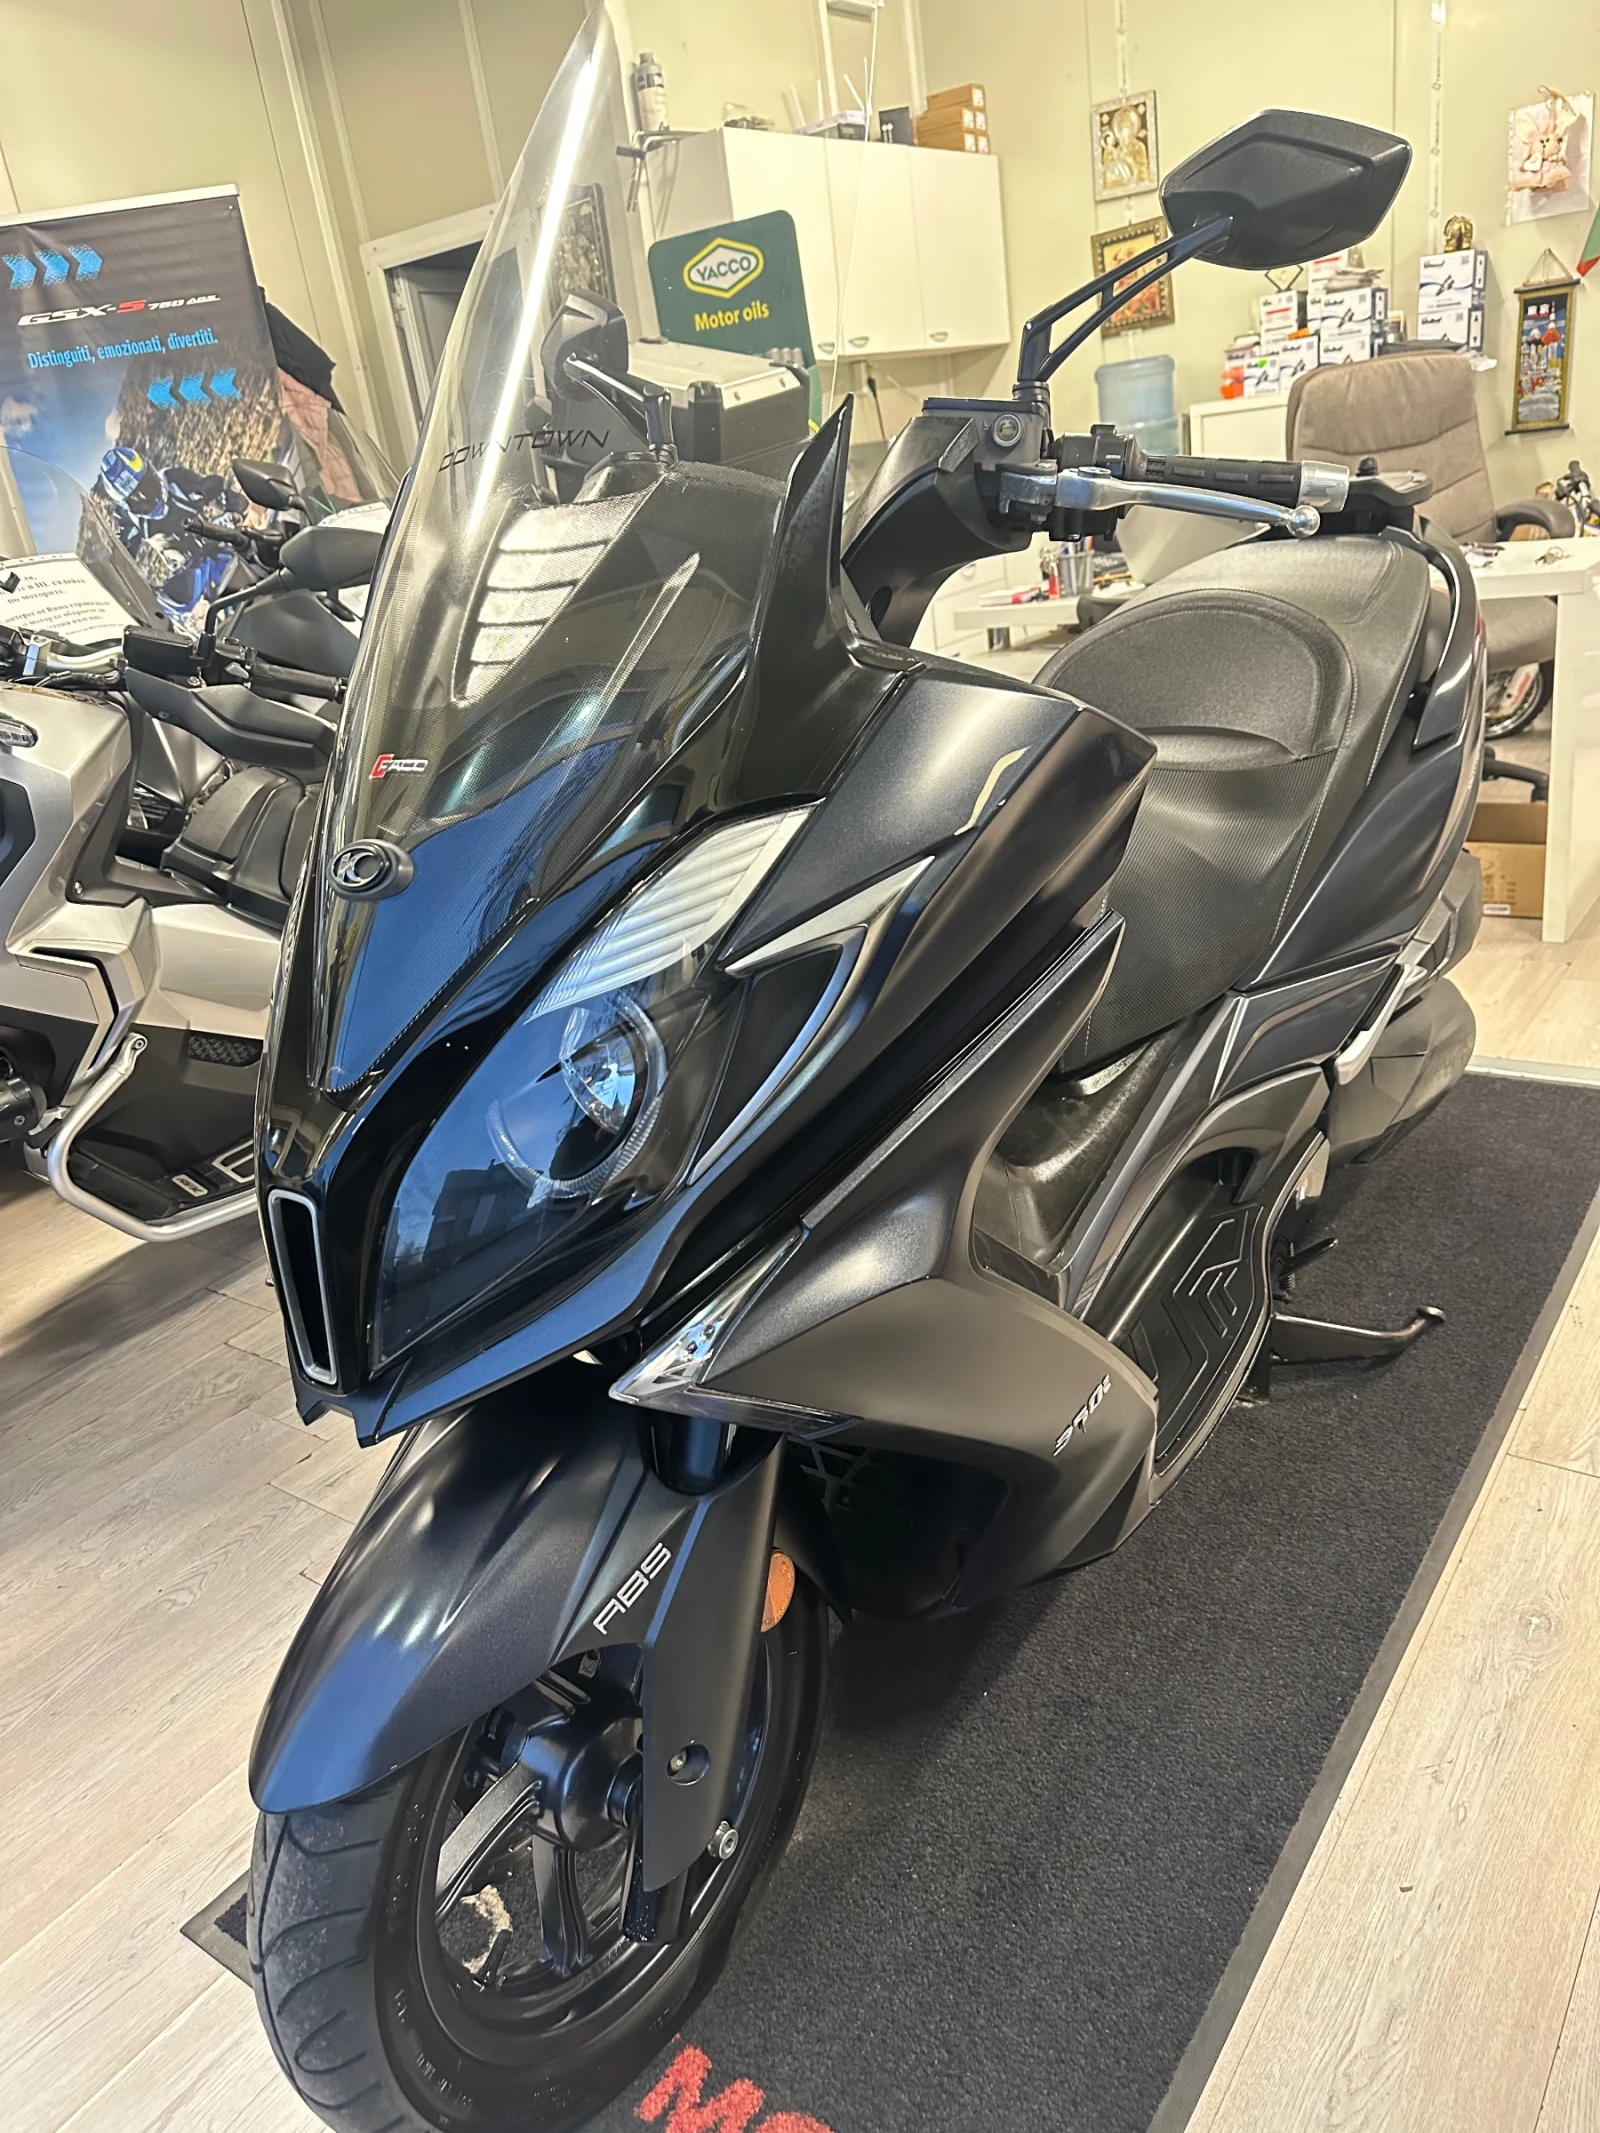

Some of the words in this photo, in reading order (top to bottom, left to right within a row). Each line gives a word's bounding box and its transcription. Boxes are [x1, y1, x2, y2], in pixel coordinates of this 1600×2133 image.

[696, 256, 752, 282] YACCO
[17, 299, 147, 327] GSX-S
[693, 308, 740, 332] Motor
[742, 299, 770, 321] oils
[27, 344, 96, 369] Distinguiti,
[97, 336, 167, 361] emozionati,
[167, 327, 219, 351] divertiti.
[592, 1542, 672, 1635] ABS
